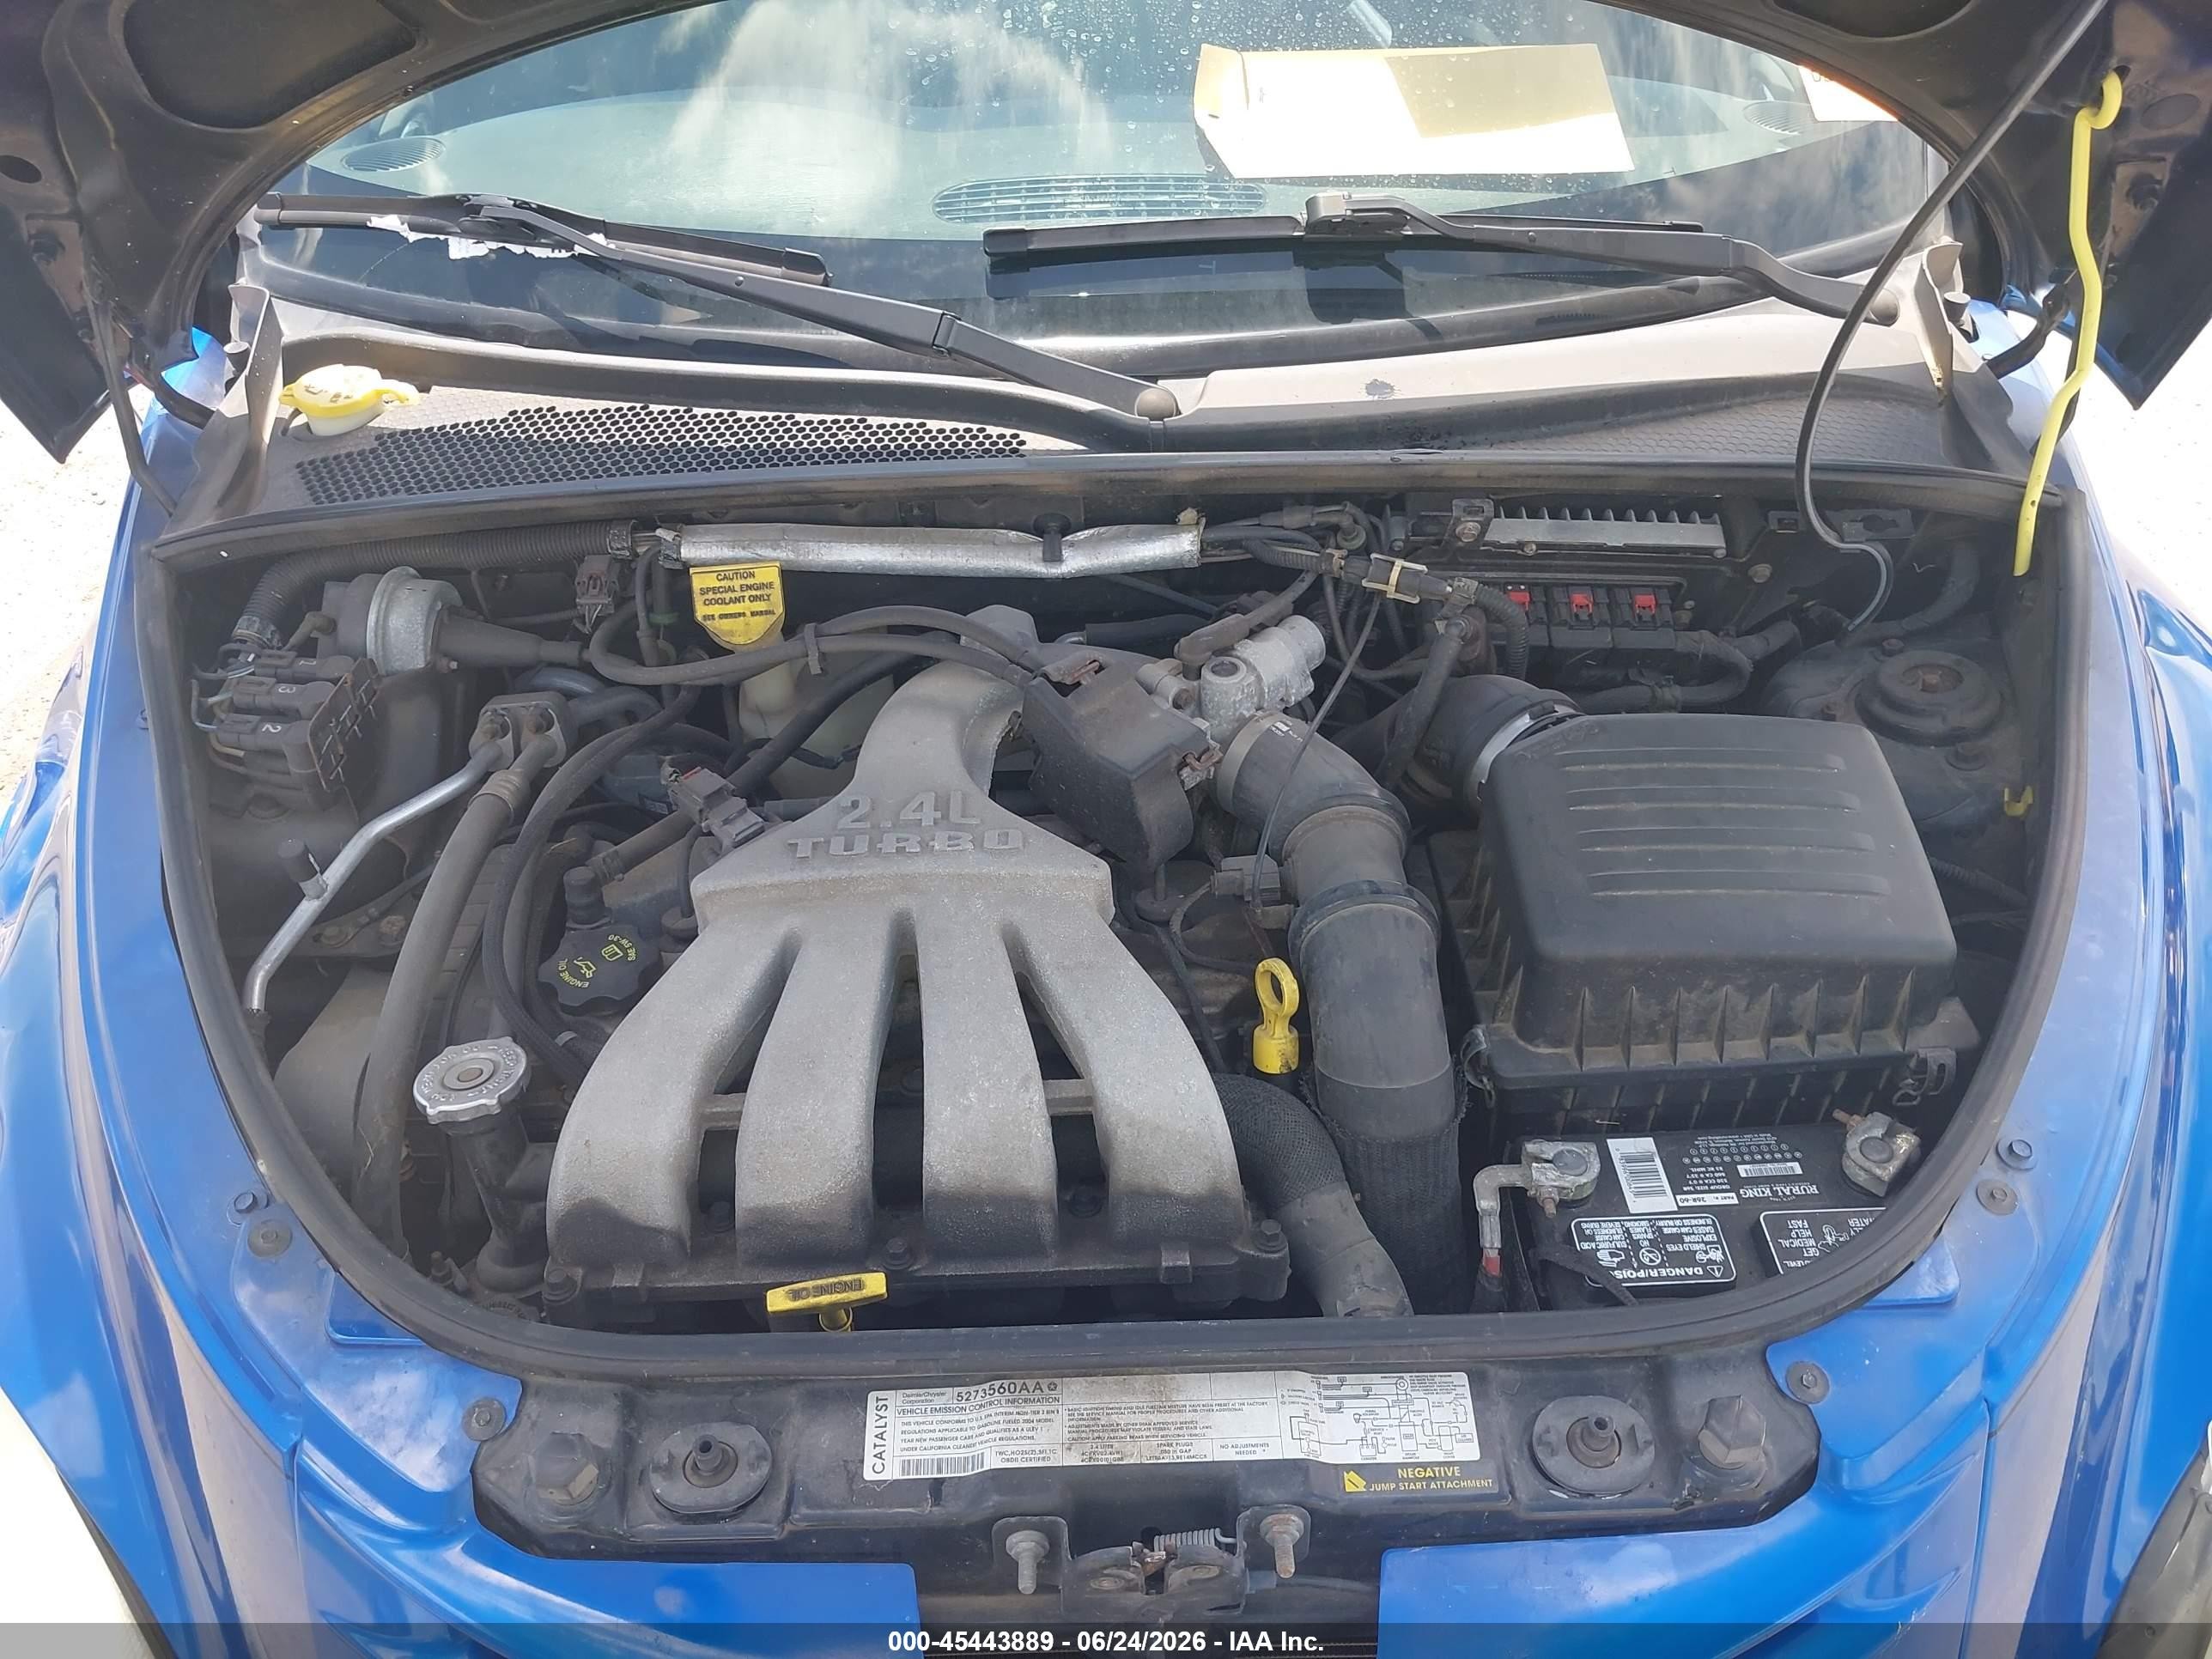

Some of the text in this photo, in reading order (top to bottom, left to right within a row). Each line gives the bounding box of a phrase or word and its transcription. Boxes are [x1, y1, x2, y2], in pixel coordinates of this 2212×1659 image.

[716, 570, 756, 581] CAUTION
[700, 581, 775, 595] SPECIAL ENGINE
[703, 593, 771, 606] COOLANT ONLY
[262, 724, 282, 732] 2
[837, 790, 981, 830] 2.4L
[787, 830, 1024, 859] TURBO
[608, 934, 636, 961] SAE 5W-30
[557, 958, 589, 988] ENGINE OIL
[1740, 1187, 1772, 1198] KING
[1772, 1185, 1820, 1196] RURAL
[1787, 1219, 1808, 1229] FAST
[1682, 1234, 1717, 1243] EXPLOSIVE
[1791, 1229, 1813, 1237] HELP
[1778, 1238, 1816, 1248] MEDICAL
[1803, 1248, 1820, 1256] GET
[1609, 1267, 1704, 1279] DANGER/POIS
[789, 1278, 864, 1301] ENGINE OIL
[956, 1381, 1044, 1402] 5273560AA
[930, 1406, 967, 1414] EMISSION
[968, 1397, 1003, 1412] CONTROL
[1005, 1396, 1060, 1405] INFORMATION
[978, 1420, 1000, 1429] GASOLINE
[872, 1396, 888, 1474] CATALYST
[1397, 1466, 1462, 1478] NEGATIVE
[1369, 1479, 1493, 1492] JUMP START ATTACHMENT
